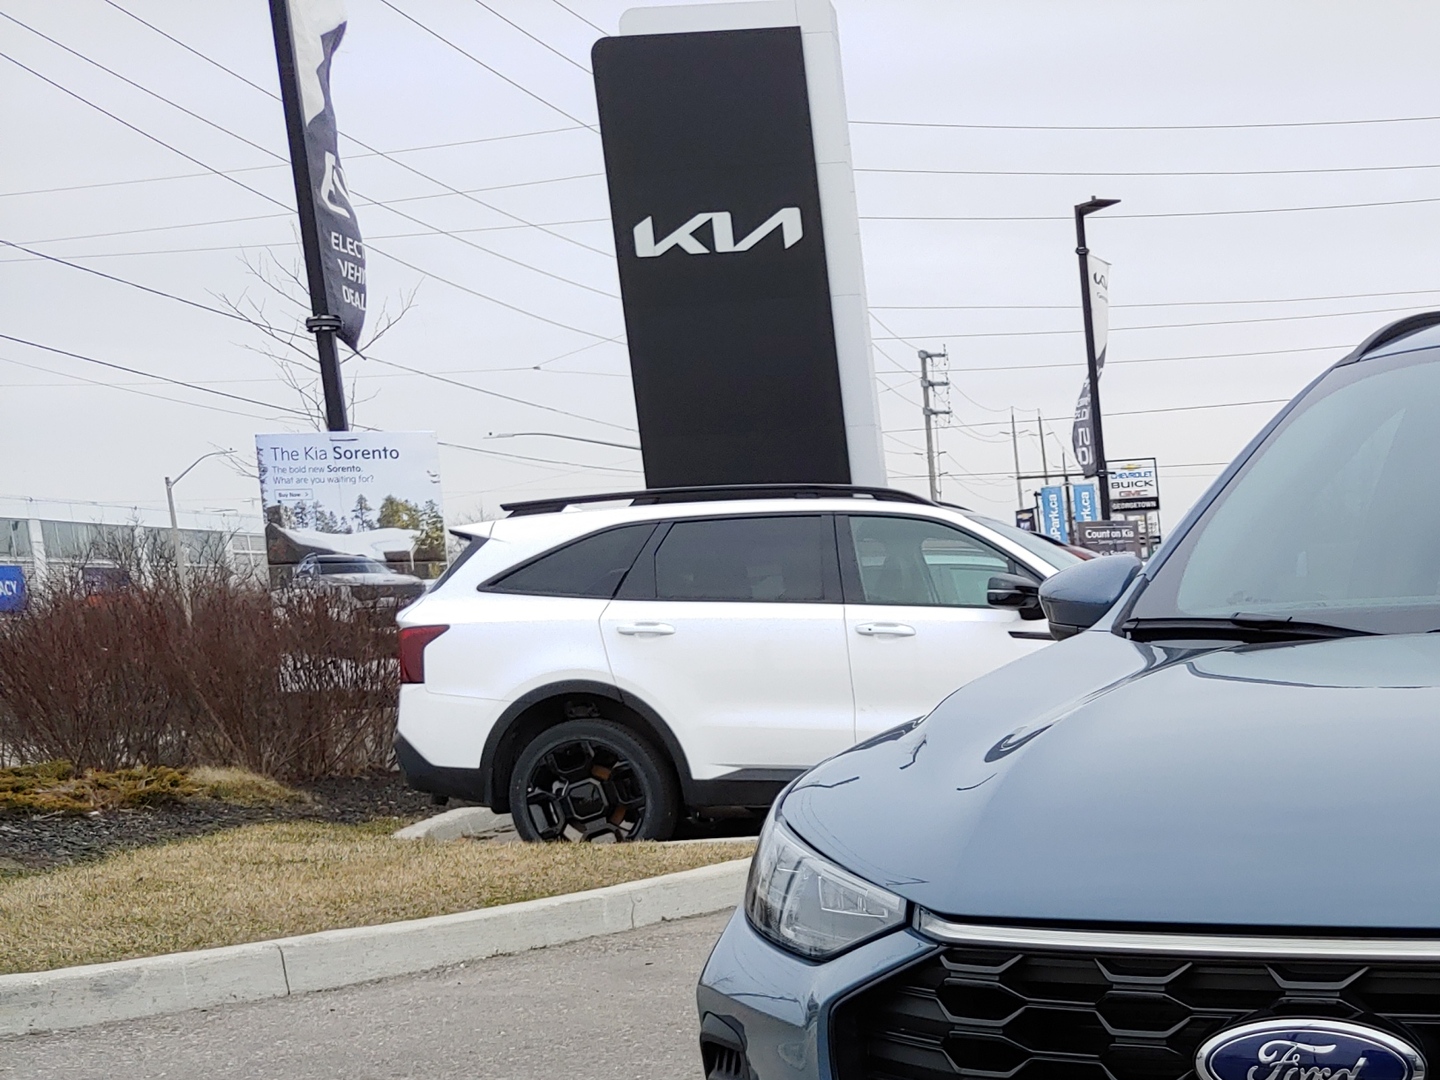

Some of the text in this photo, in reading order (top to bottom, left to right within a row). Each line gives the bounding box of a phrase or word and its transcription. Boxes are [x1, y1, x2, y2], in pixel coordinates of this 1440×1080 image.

[633, 206, 803, 258] KIA
[270, 446, 400, 461] The Kia Sorento
[272, 465, 286, 474] The
[289, 465, 307, 474] bold
[273, 476, 293, 485] What
[310, 477, 325, 486] you
[327, 475, 357, 485] waiting
[358, 474, 374, 484] for?
[1111, 480, 1154, 489] BUICK
[1119, 489, 1149, 497] GMC
[1085, 529, 1134, 539] Count on Kia
